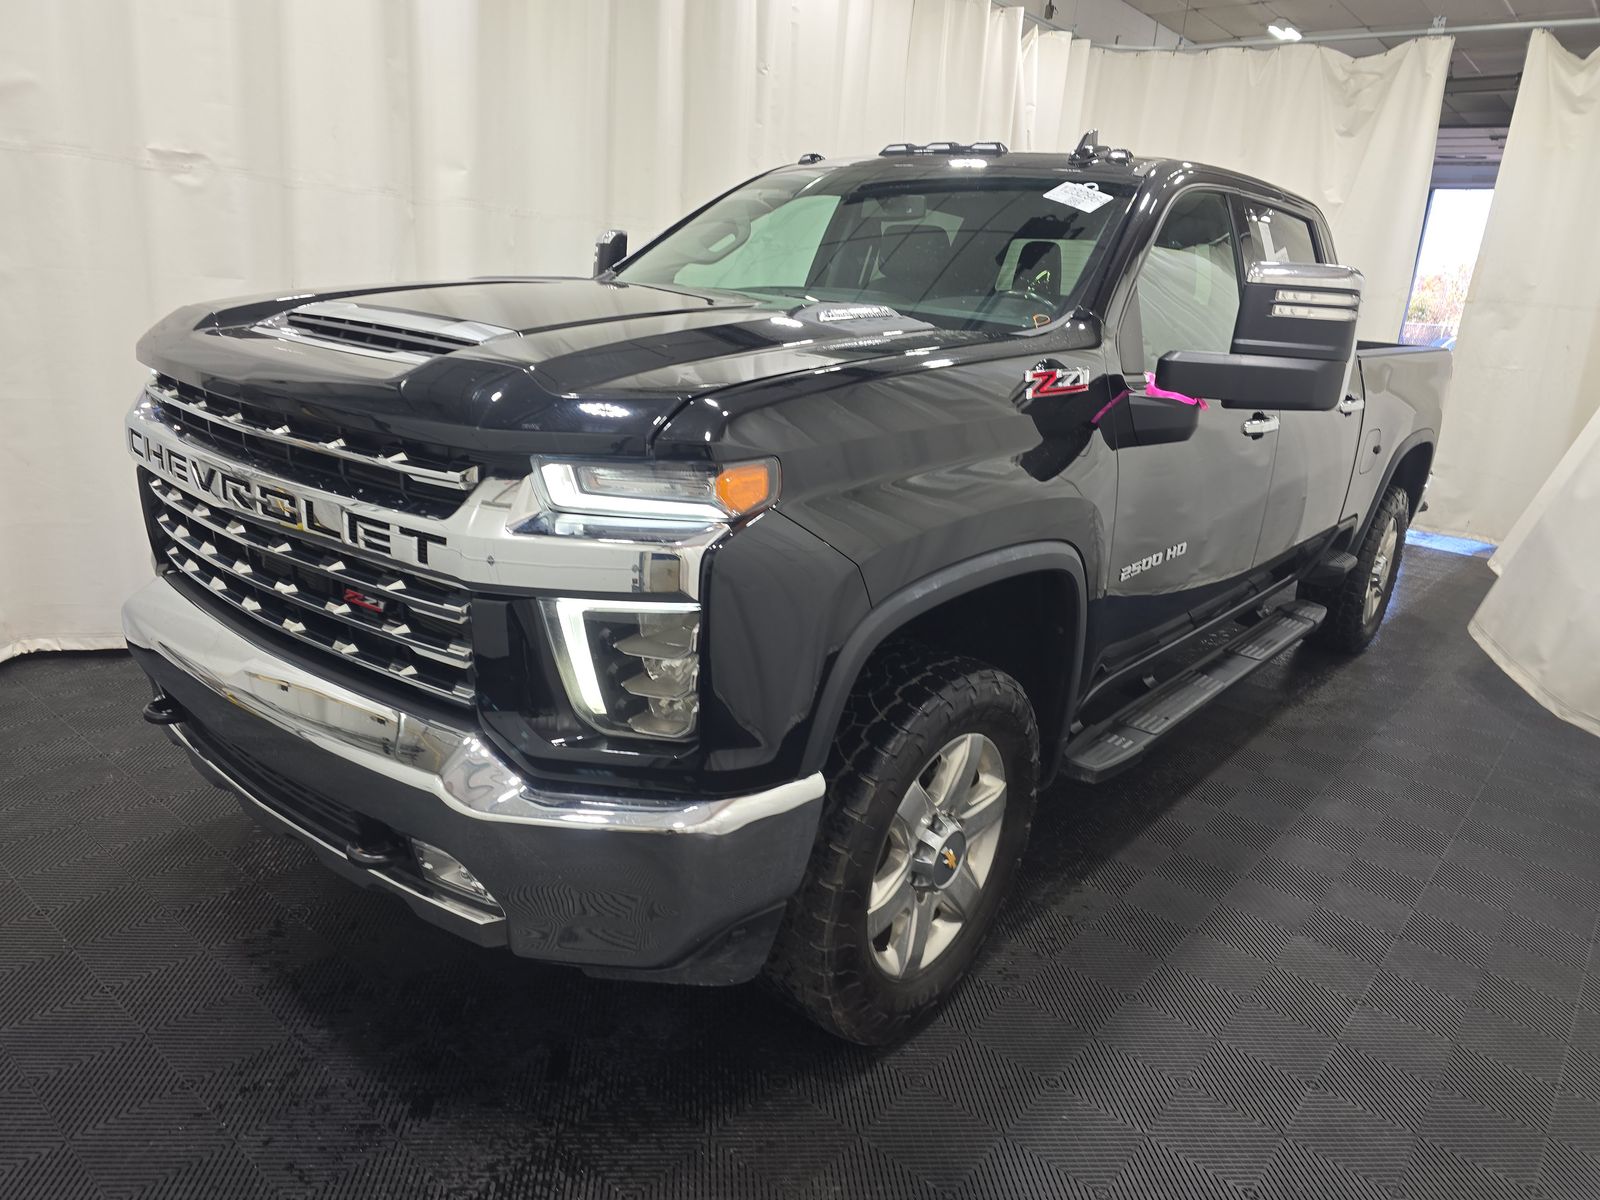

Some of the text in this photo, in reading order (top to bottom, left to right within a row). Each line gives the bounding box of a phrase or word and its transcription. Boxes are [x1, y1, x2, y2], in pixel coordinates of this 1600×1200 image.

[1025, 367, 1090, 400] Z71
[128, 426, 447, 565] CHEVROLET
[1119, 541, 1188, 582] 2500 HD
